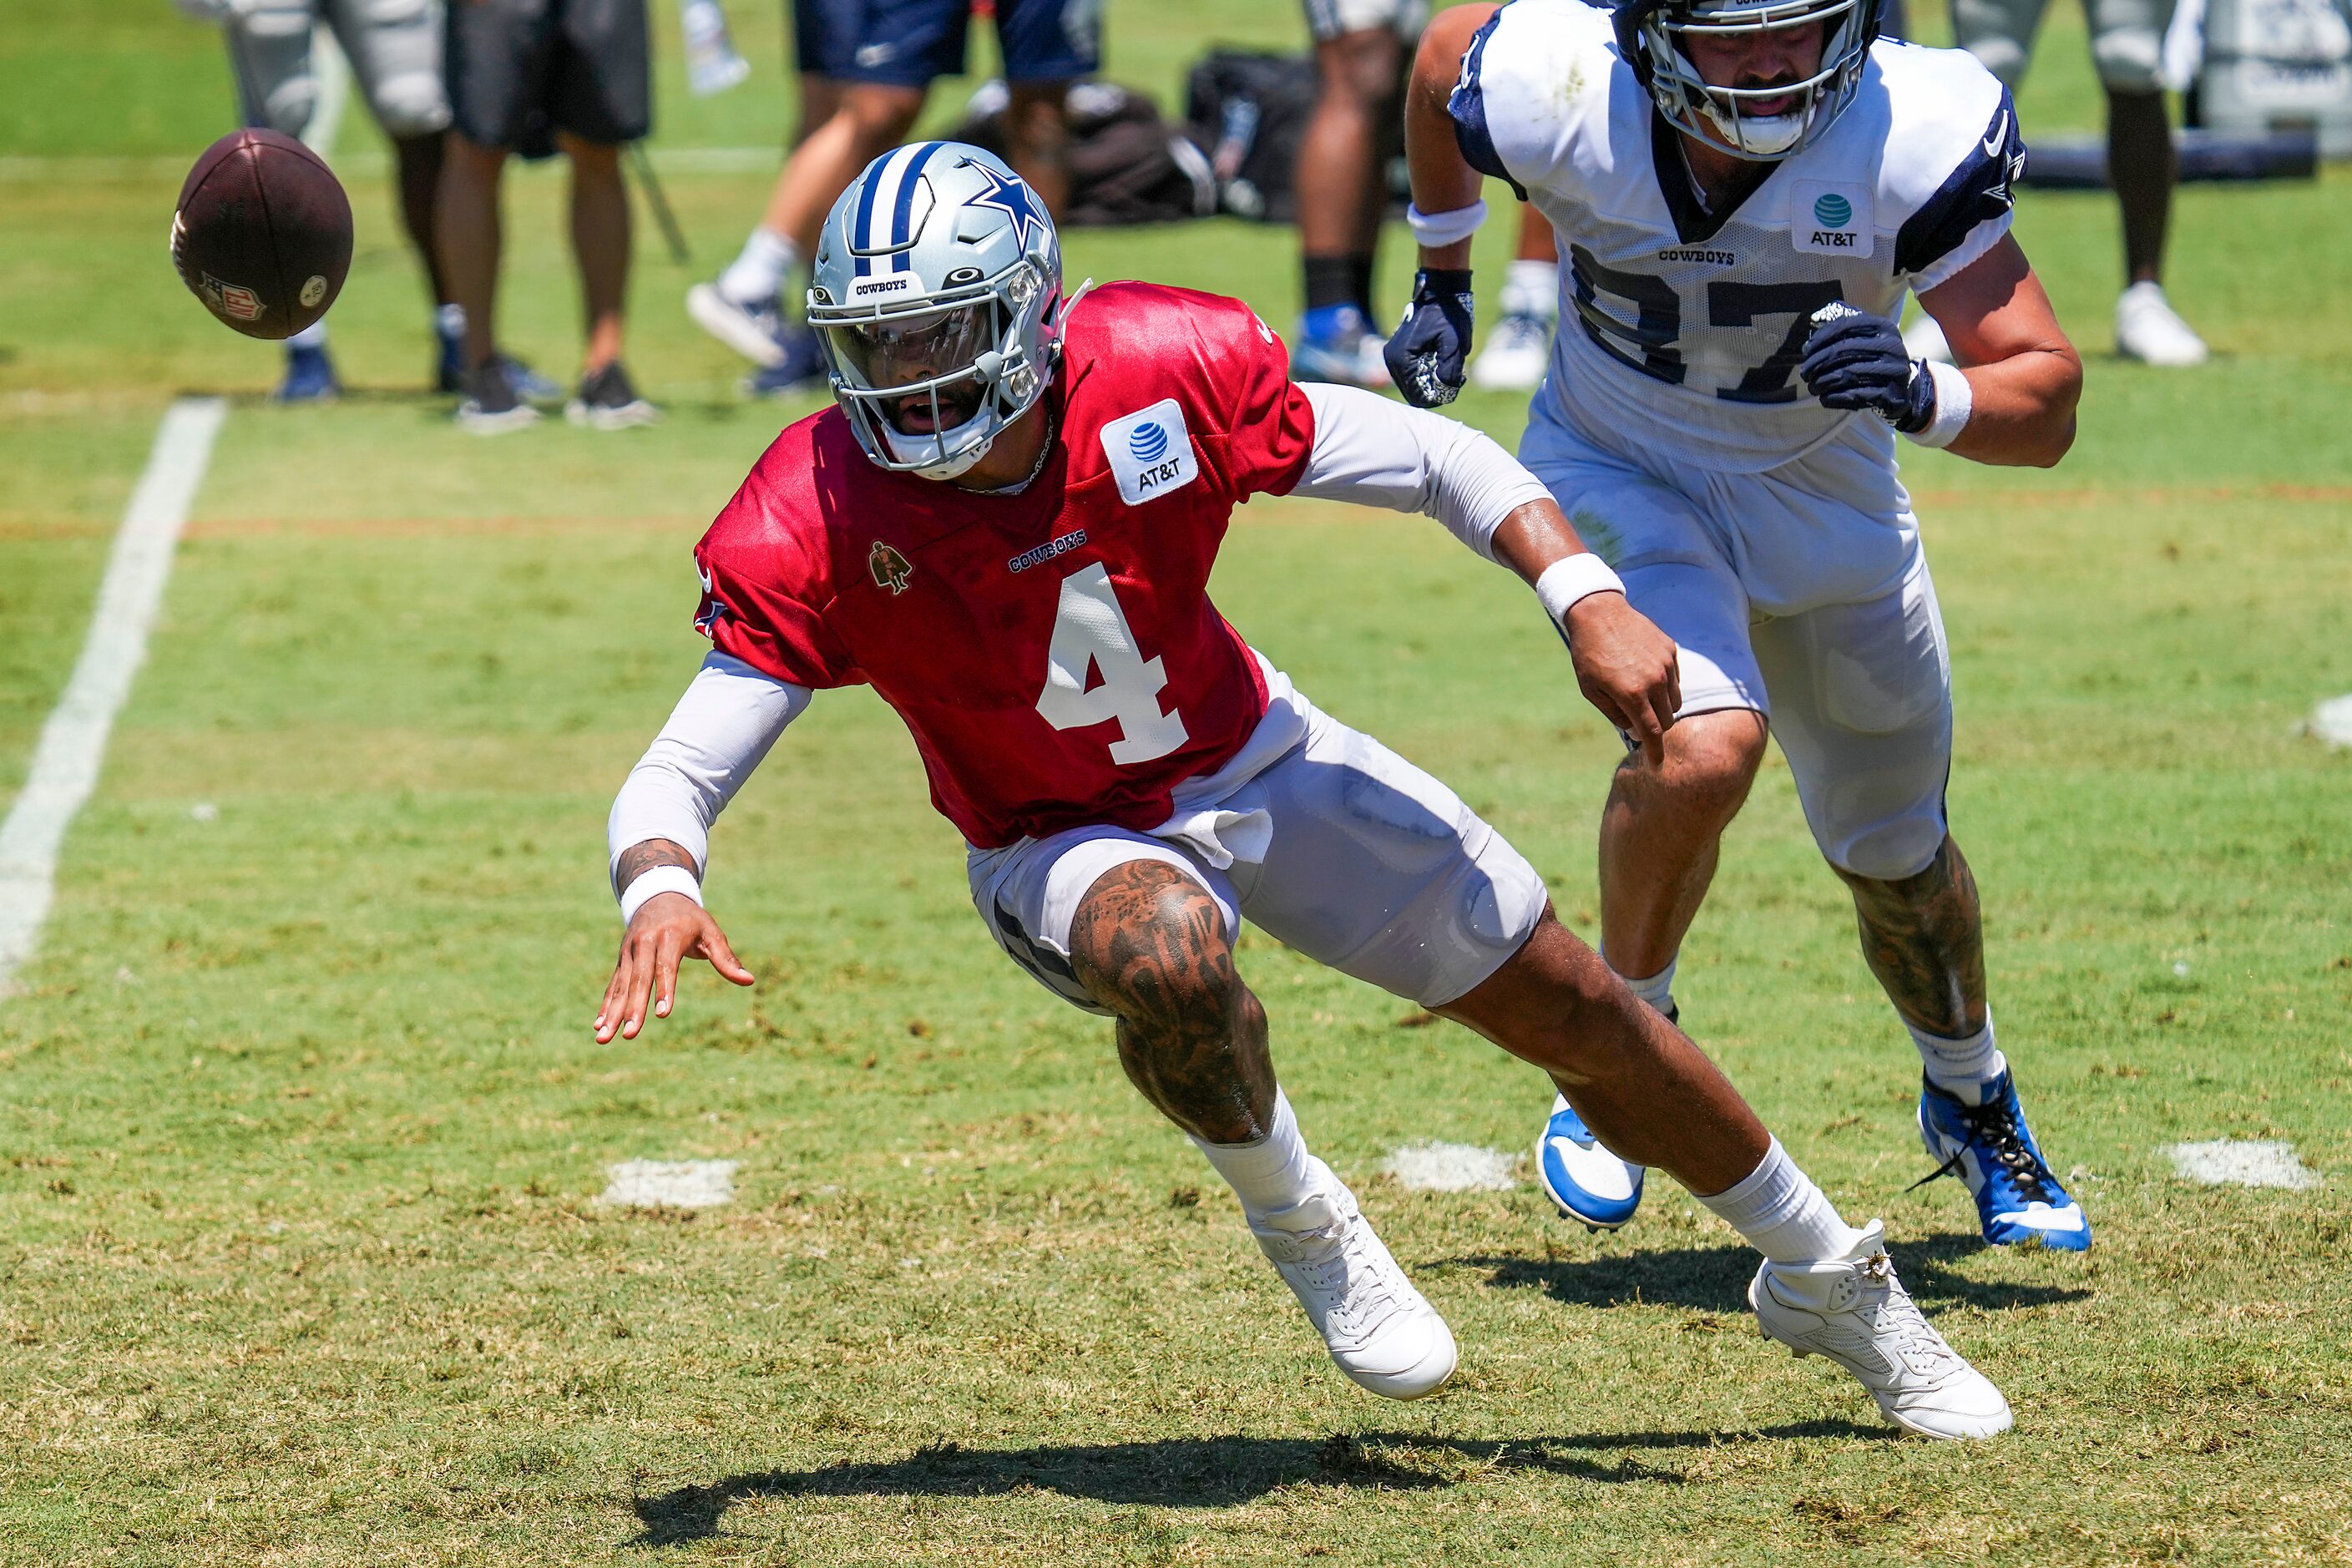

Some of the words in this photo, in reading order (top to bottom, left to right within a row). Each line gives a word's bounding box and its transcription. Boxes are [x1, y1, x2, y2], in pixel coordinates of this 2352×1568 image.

[1810, 231, 1858, 247] AT&T
[1659, 250, 1735, 266] COWBOYS
[856, 279, 908, 296] COWBOYS
[225, 290, 255, 316] NFL
[1139, 457, 1180, 493] AT&T
[1009, 529, 1087, 573] COWBOYS
[1034, 561, 1190, 766] 4
